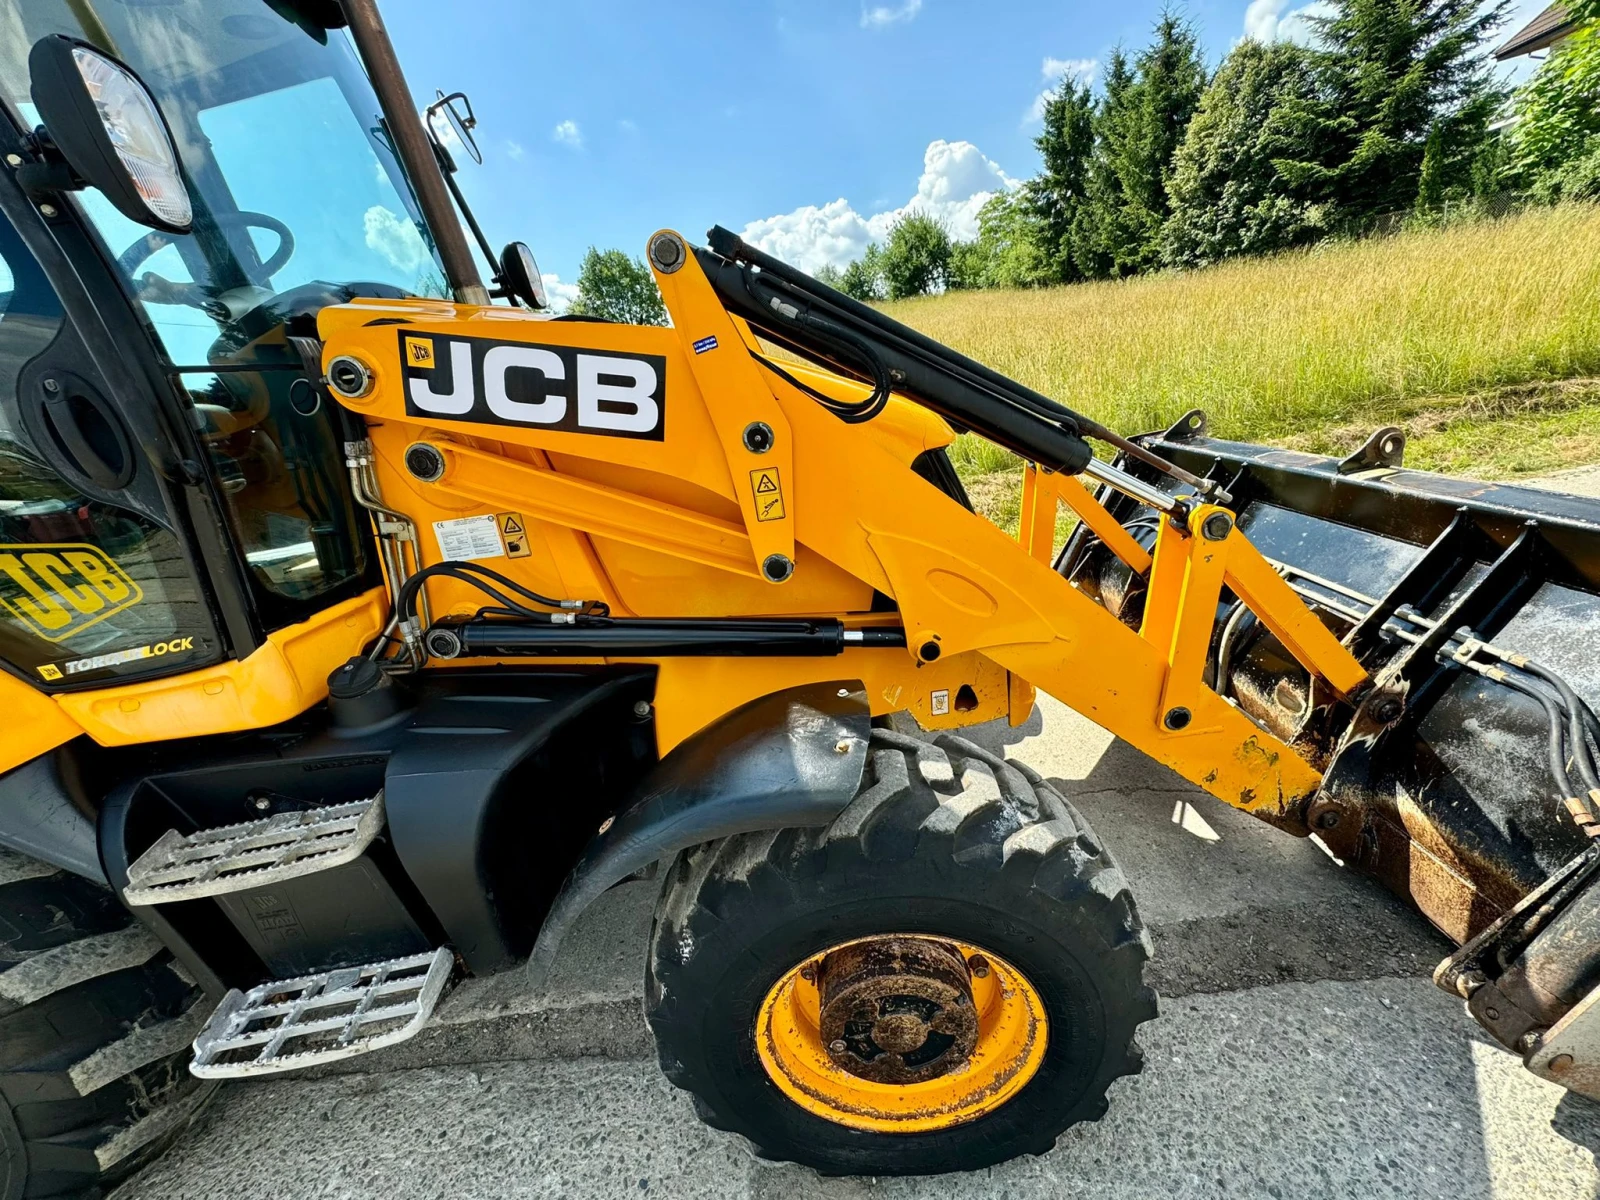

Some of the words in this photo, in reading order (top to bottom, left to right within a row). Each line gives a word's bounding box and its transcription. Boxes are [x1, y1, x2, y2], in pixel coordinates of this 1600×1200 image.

[409, 341, 659, 432] JCB
[413, 344, 430, 360] JCB
[0, 552, 130, 630] JCB
